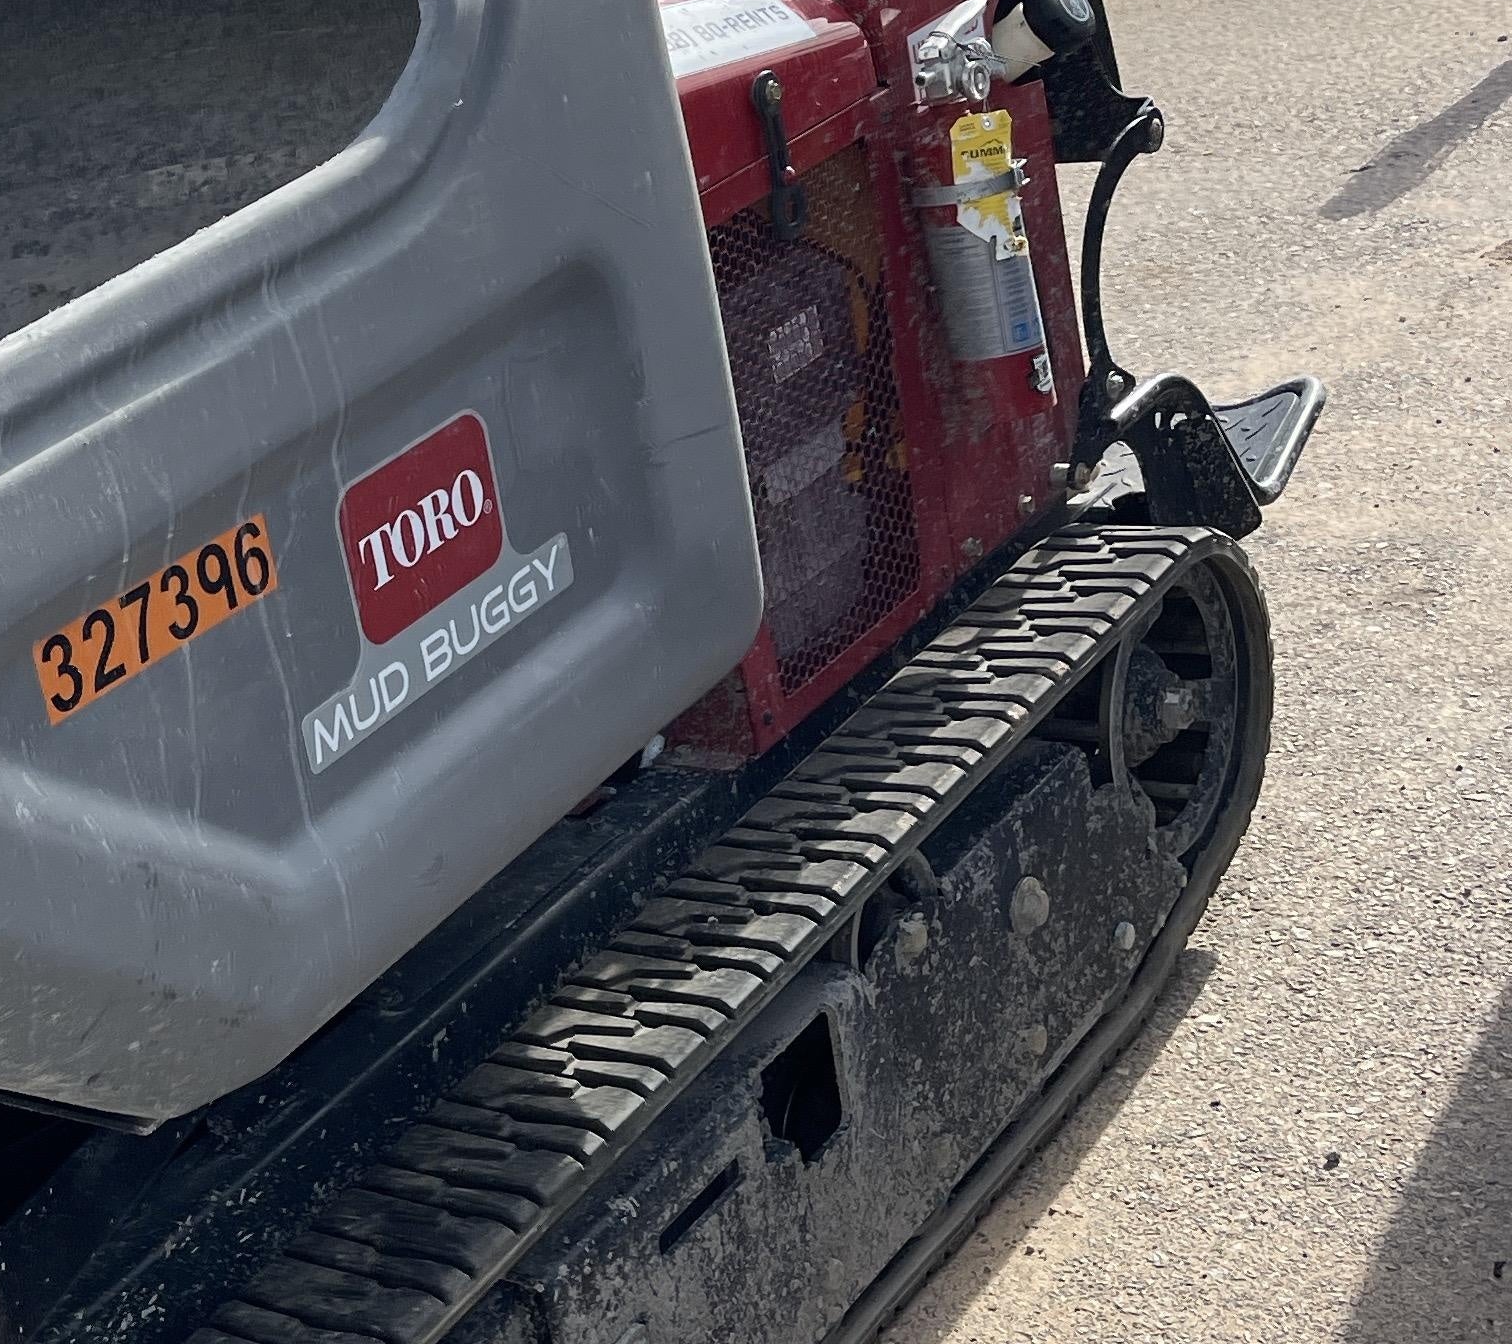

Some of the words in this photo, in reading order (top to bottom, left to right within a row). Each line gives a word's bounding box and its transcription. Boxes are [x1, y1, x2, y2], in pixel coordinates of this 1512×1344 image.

[41, 522, 270, 713] 327396
[357, 469, 486, 591] TORO
[313, 661, 410, 765] MUD
[419, 544, 559, 682] BUGGY
